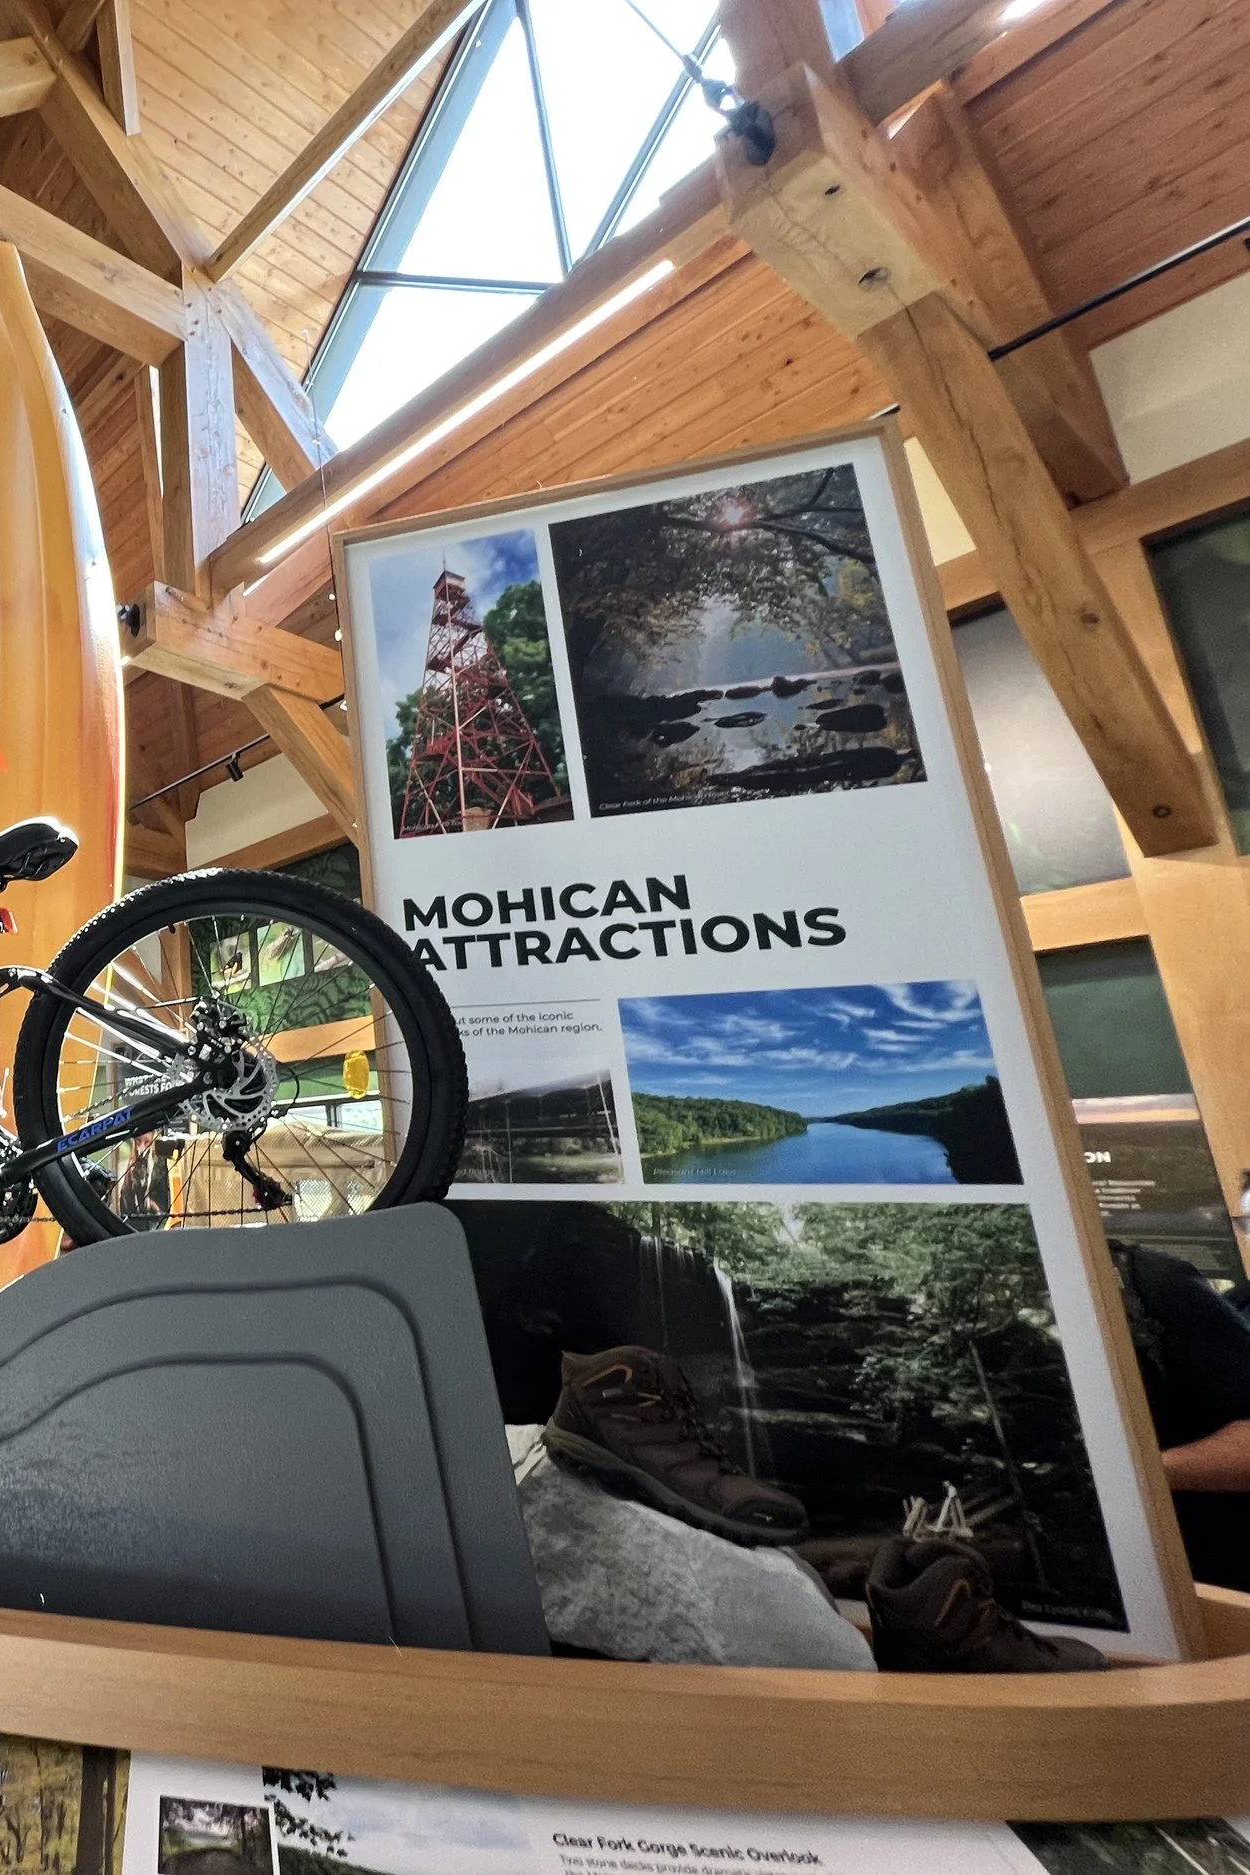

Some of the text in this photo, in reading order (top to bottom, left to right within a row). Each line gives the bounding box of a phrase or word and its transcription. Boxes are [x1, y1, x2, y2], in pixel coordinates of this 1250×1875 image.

[403, 874, 691, 931] MOHICAN
[413, 907, 847, 971] ATTRACTIONS
[469, 1016, 499, 1025] some
[503, 1013, 514, 1023] of
[516, 1013, 536, 1022] the
[539, 1011, 574, 1021] iconic
[473, 1026, 483, 1036] of
[486, 1025, 505, 1035] the
[508, 1023, 558, 1035] Mohican
[561, 1022, 603, 1034] region.
[57, 1104, 135, 1152] ECARPAT
[552, 1833, 824, 1865] Clear Fork Gorge Scenic Overlook
